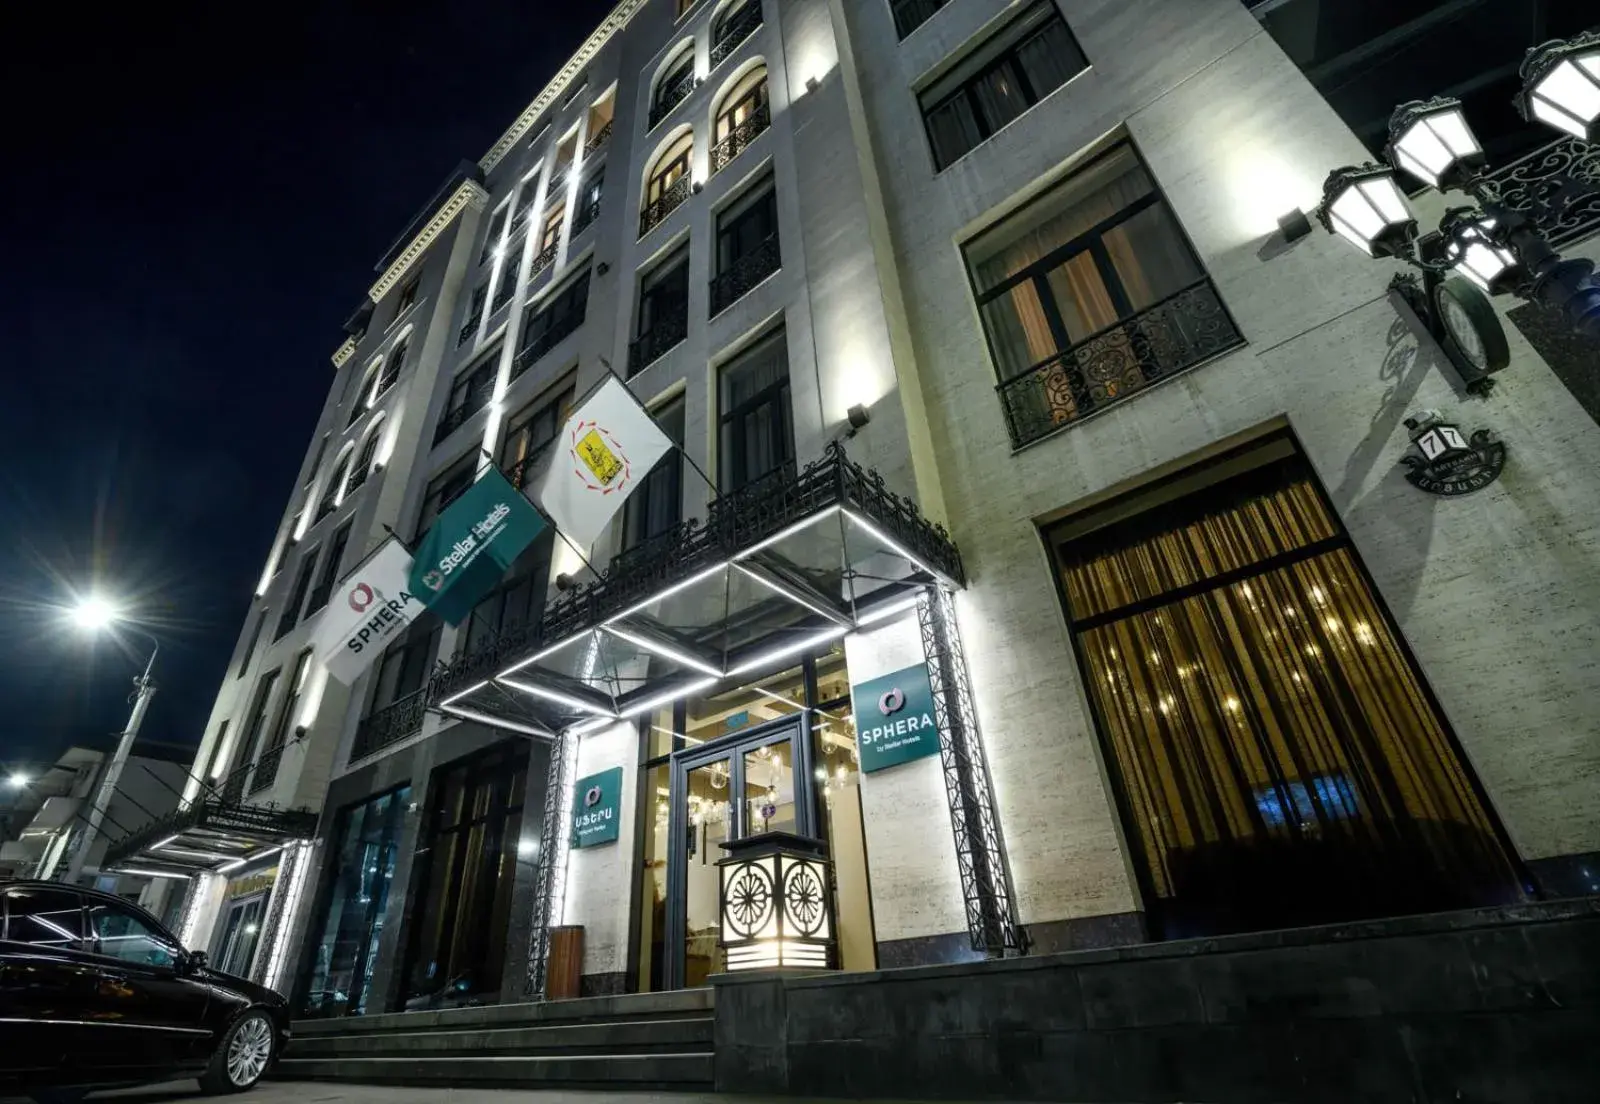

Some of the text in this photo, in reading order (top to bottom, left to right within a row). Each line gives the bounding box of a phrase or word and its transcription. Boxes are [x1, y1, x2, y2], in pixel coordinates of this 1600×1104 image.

[438, 534, 477, 576] Stellar
[471, 503, 511, 539] Hotels
[347, 591, 413, 654] SPHERA
[862, 713, 934, 745] SPHERA
